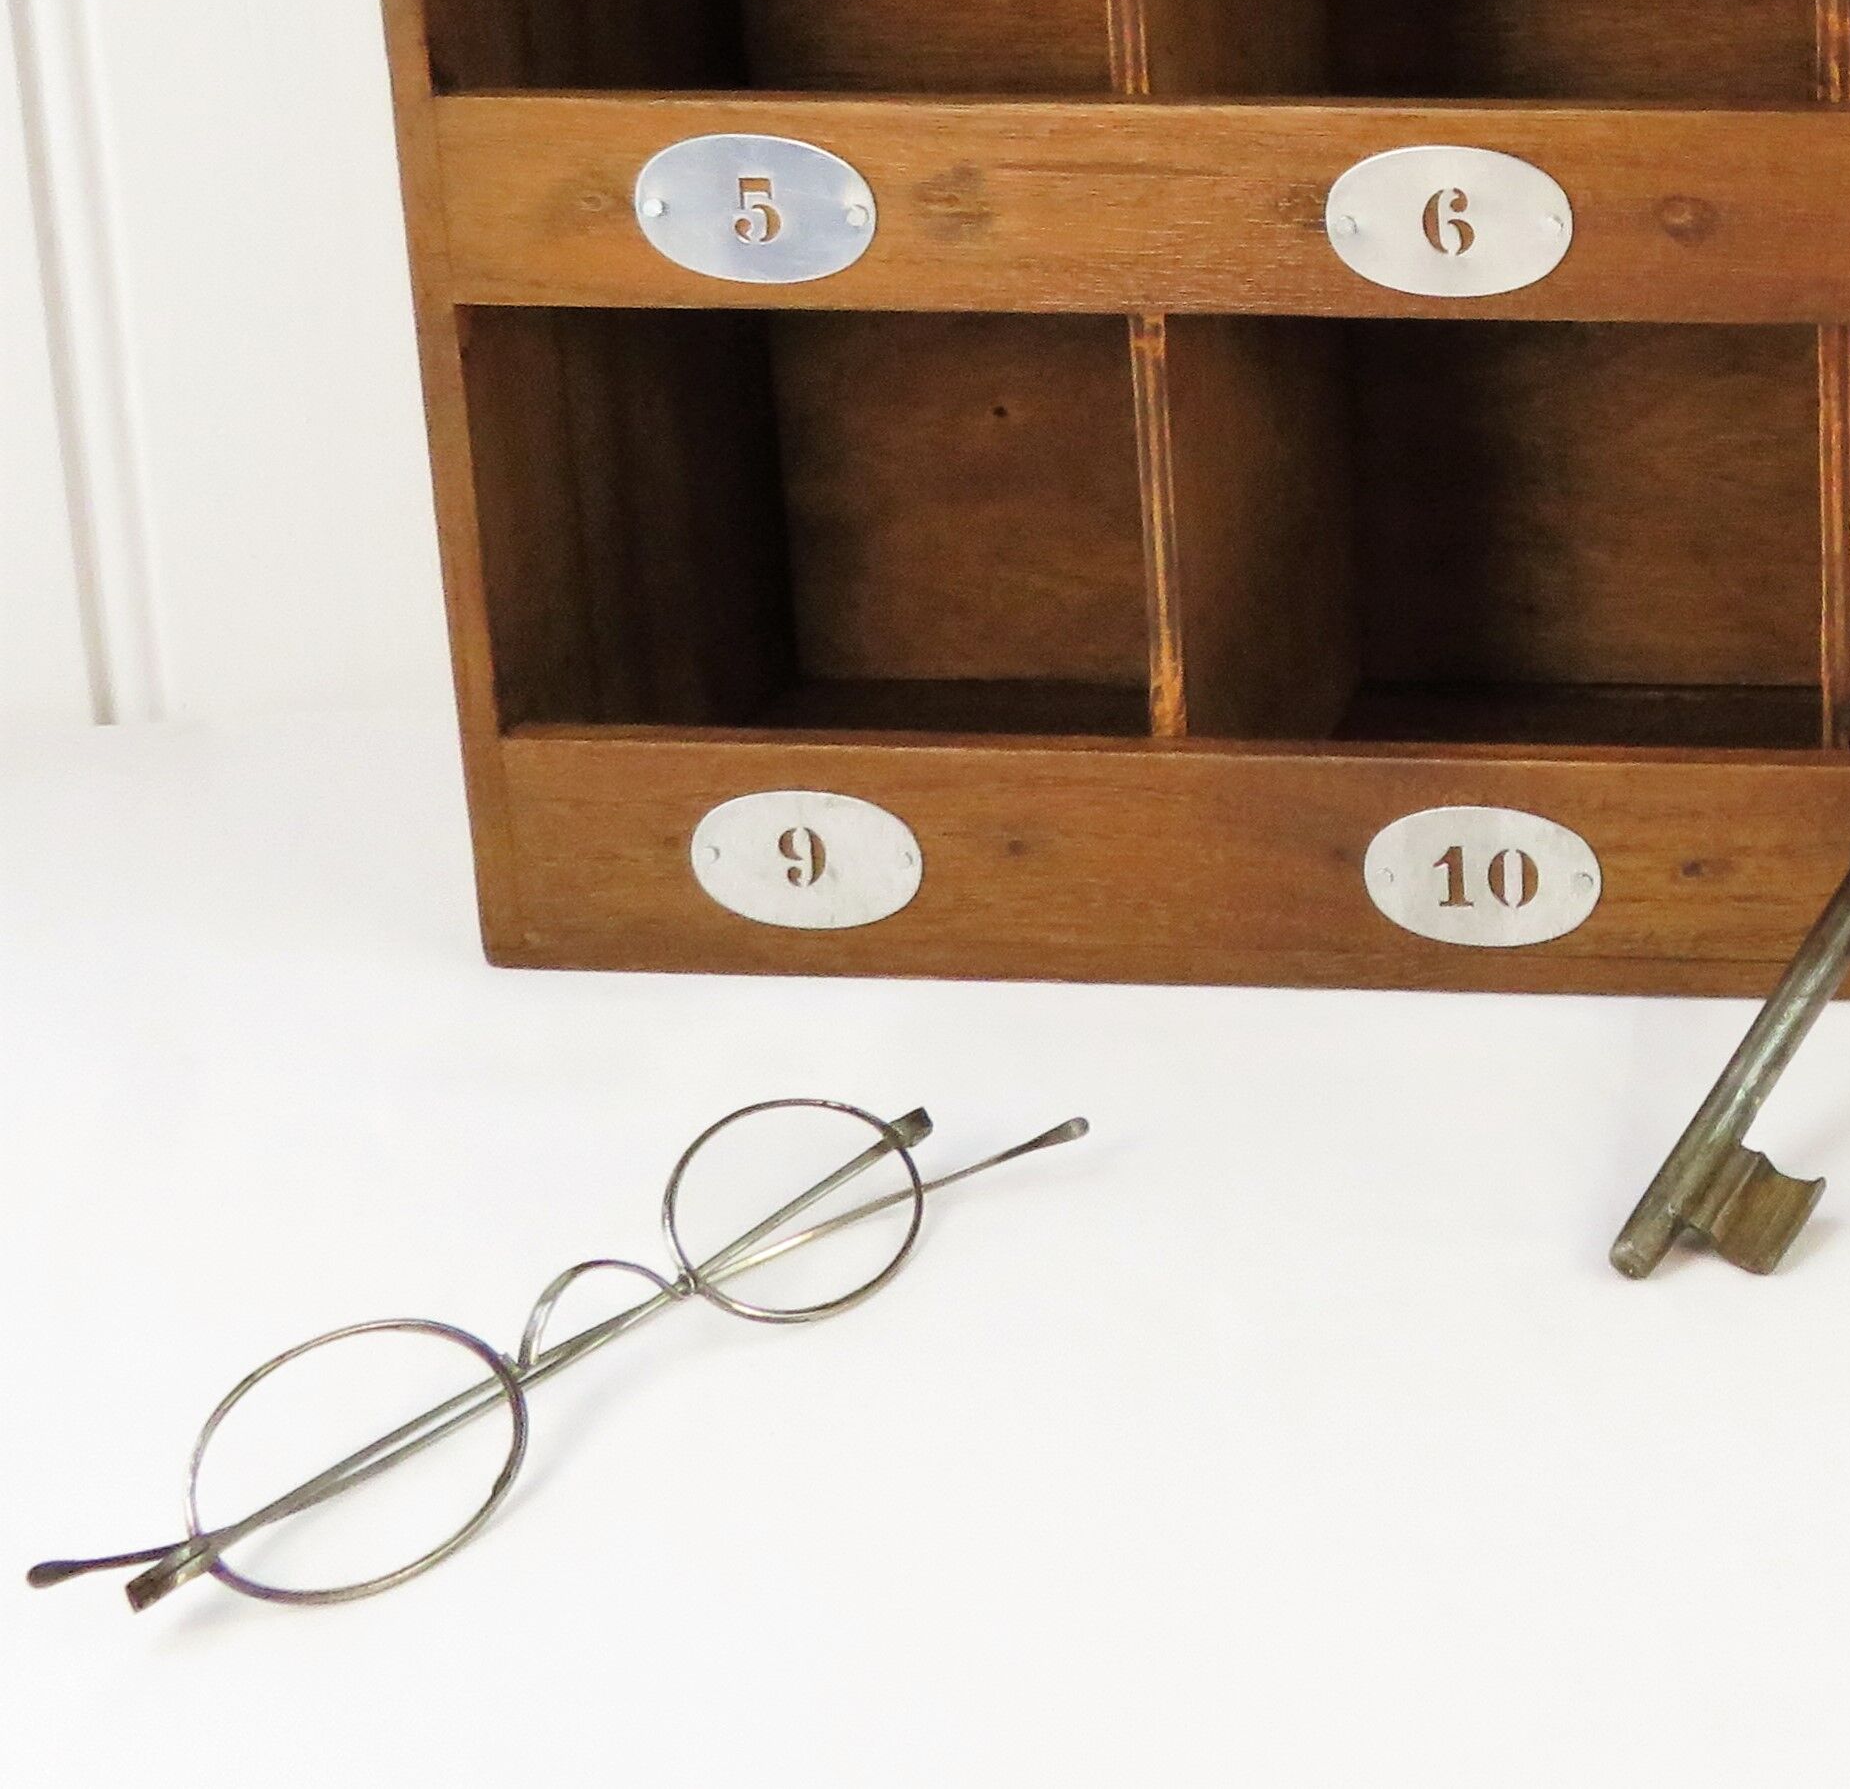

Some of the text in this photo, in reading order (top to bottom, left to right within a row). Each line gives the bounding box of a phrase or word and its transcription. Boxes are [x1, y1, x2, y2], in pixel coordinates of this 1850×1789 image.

[735, 177, 781, 244] 5
[1423, 189, 1475, 254] 6
[779, 827, 825, 887] 9
[1435, 845, 1540, 907] 10
